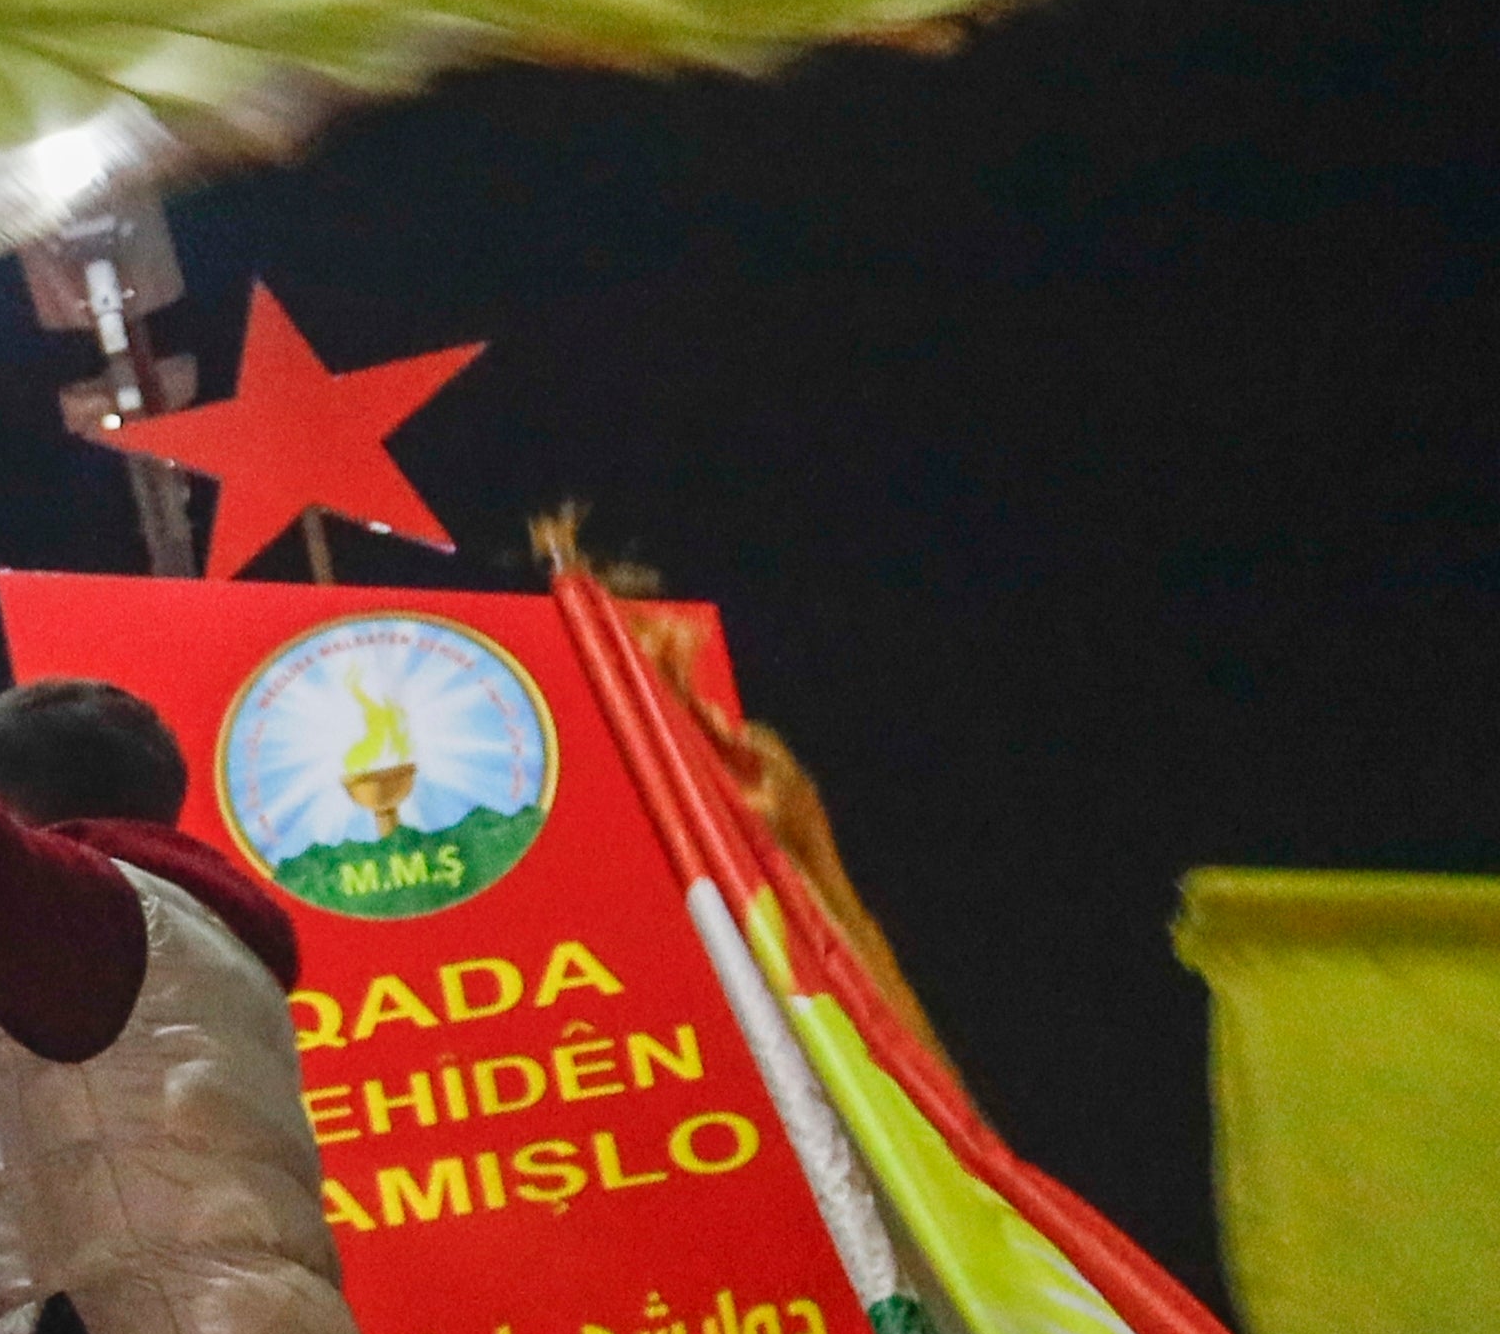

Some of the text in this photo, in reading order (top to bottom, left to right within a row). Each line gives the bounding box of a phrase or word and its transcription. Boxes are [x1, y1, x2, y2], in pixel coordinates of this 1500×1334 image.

[287, 940, 625, 1051] QADA
[301, 1020, 705, 1145] EHÎDÊN
[321, 1111, 761, 1233] AMIŞLO
